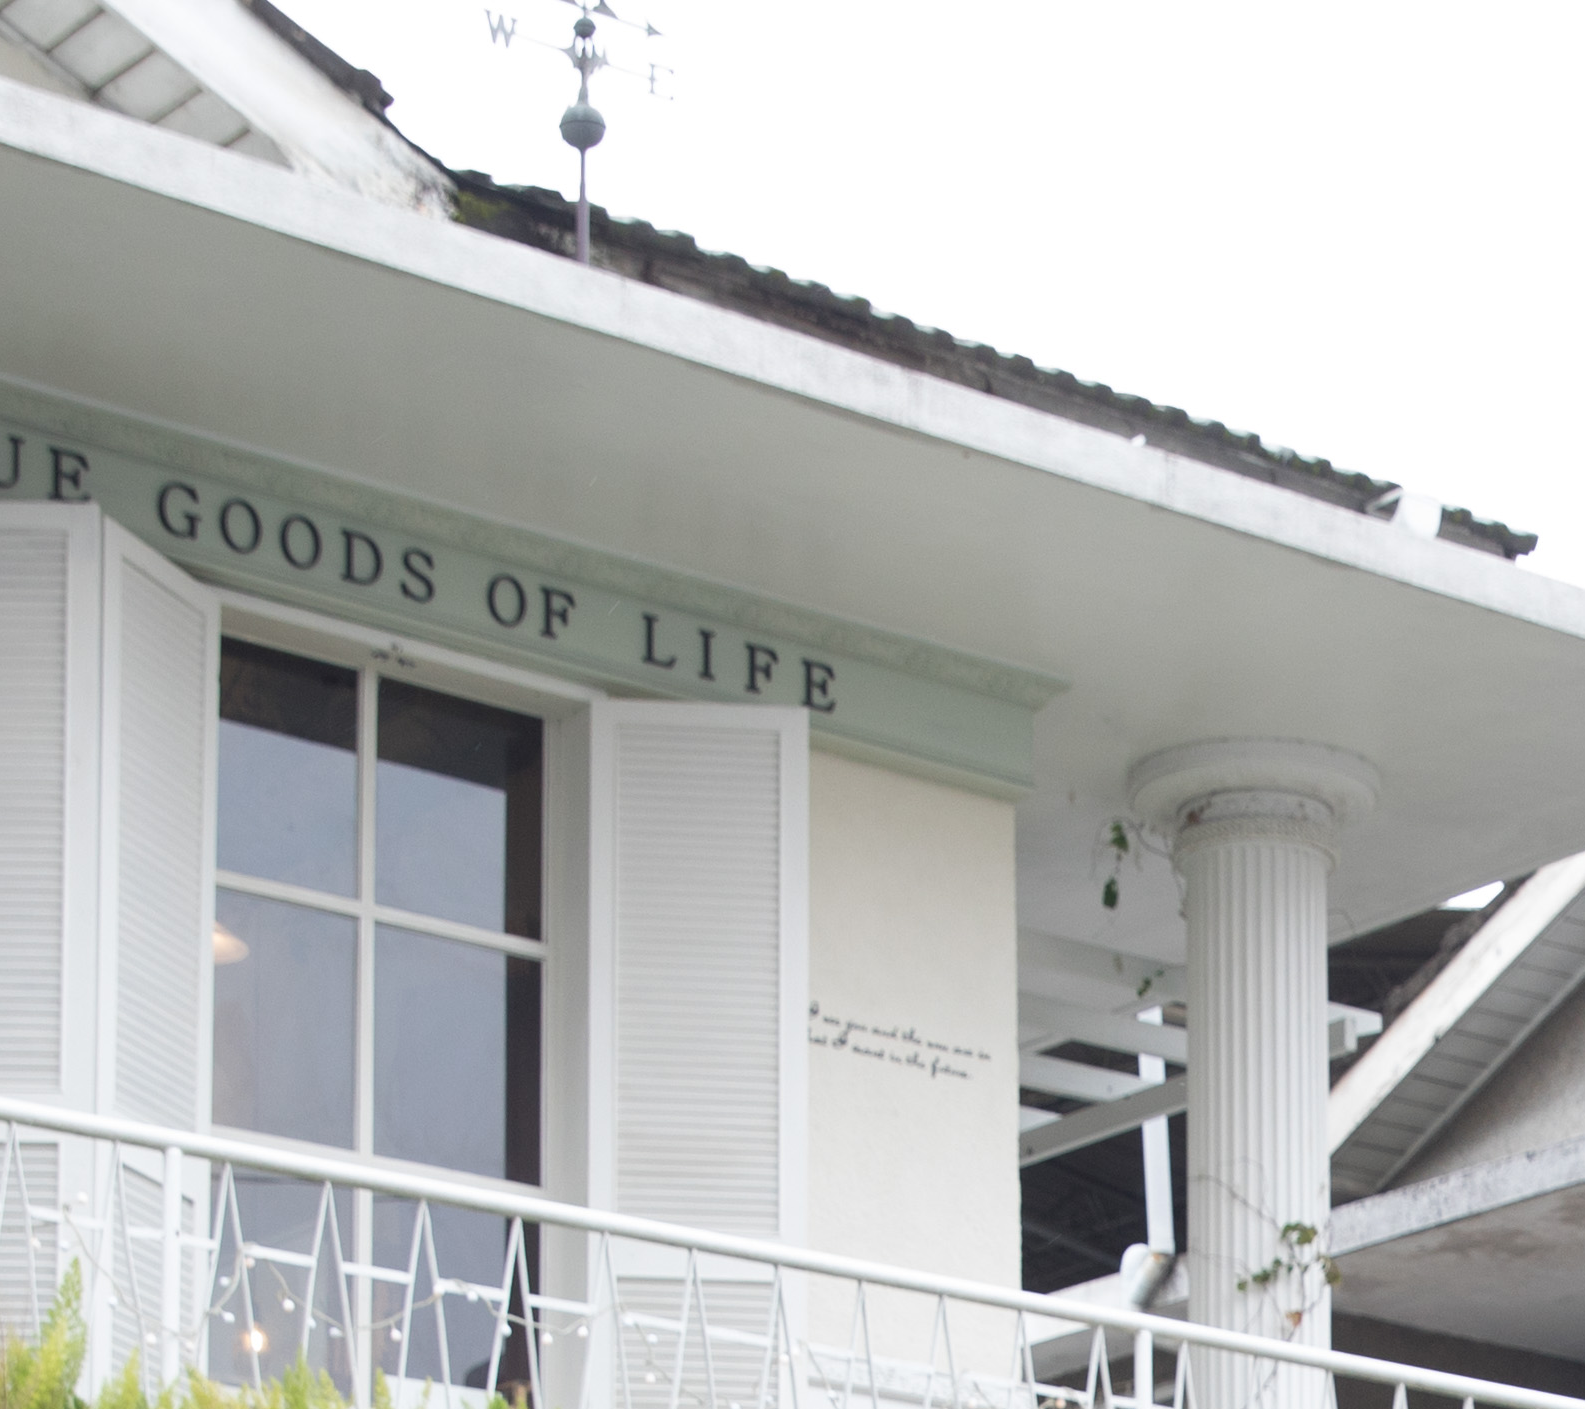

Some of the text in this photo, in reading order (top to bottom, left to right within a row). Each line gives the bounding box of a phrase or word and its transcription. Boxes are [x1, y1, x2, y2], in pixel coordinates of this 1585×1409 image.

[156, 482, 436, 604] GOODS
[486, 575, 578, 639] OF
[639, 613, 838, 714] LIFE
